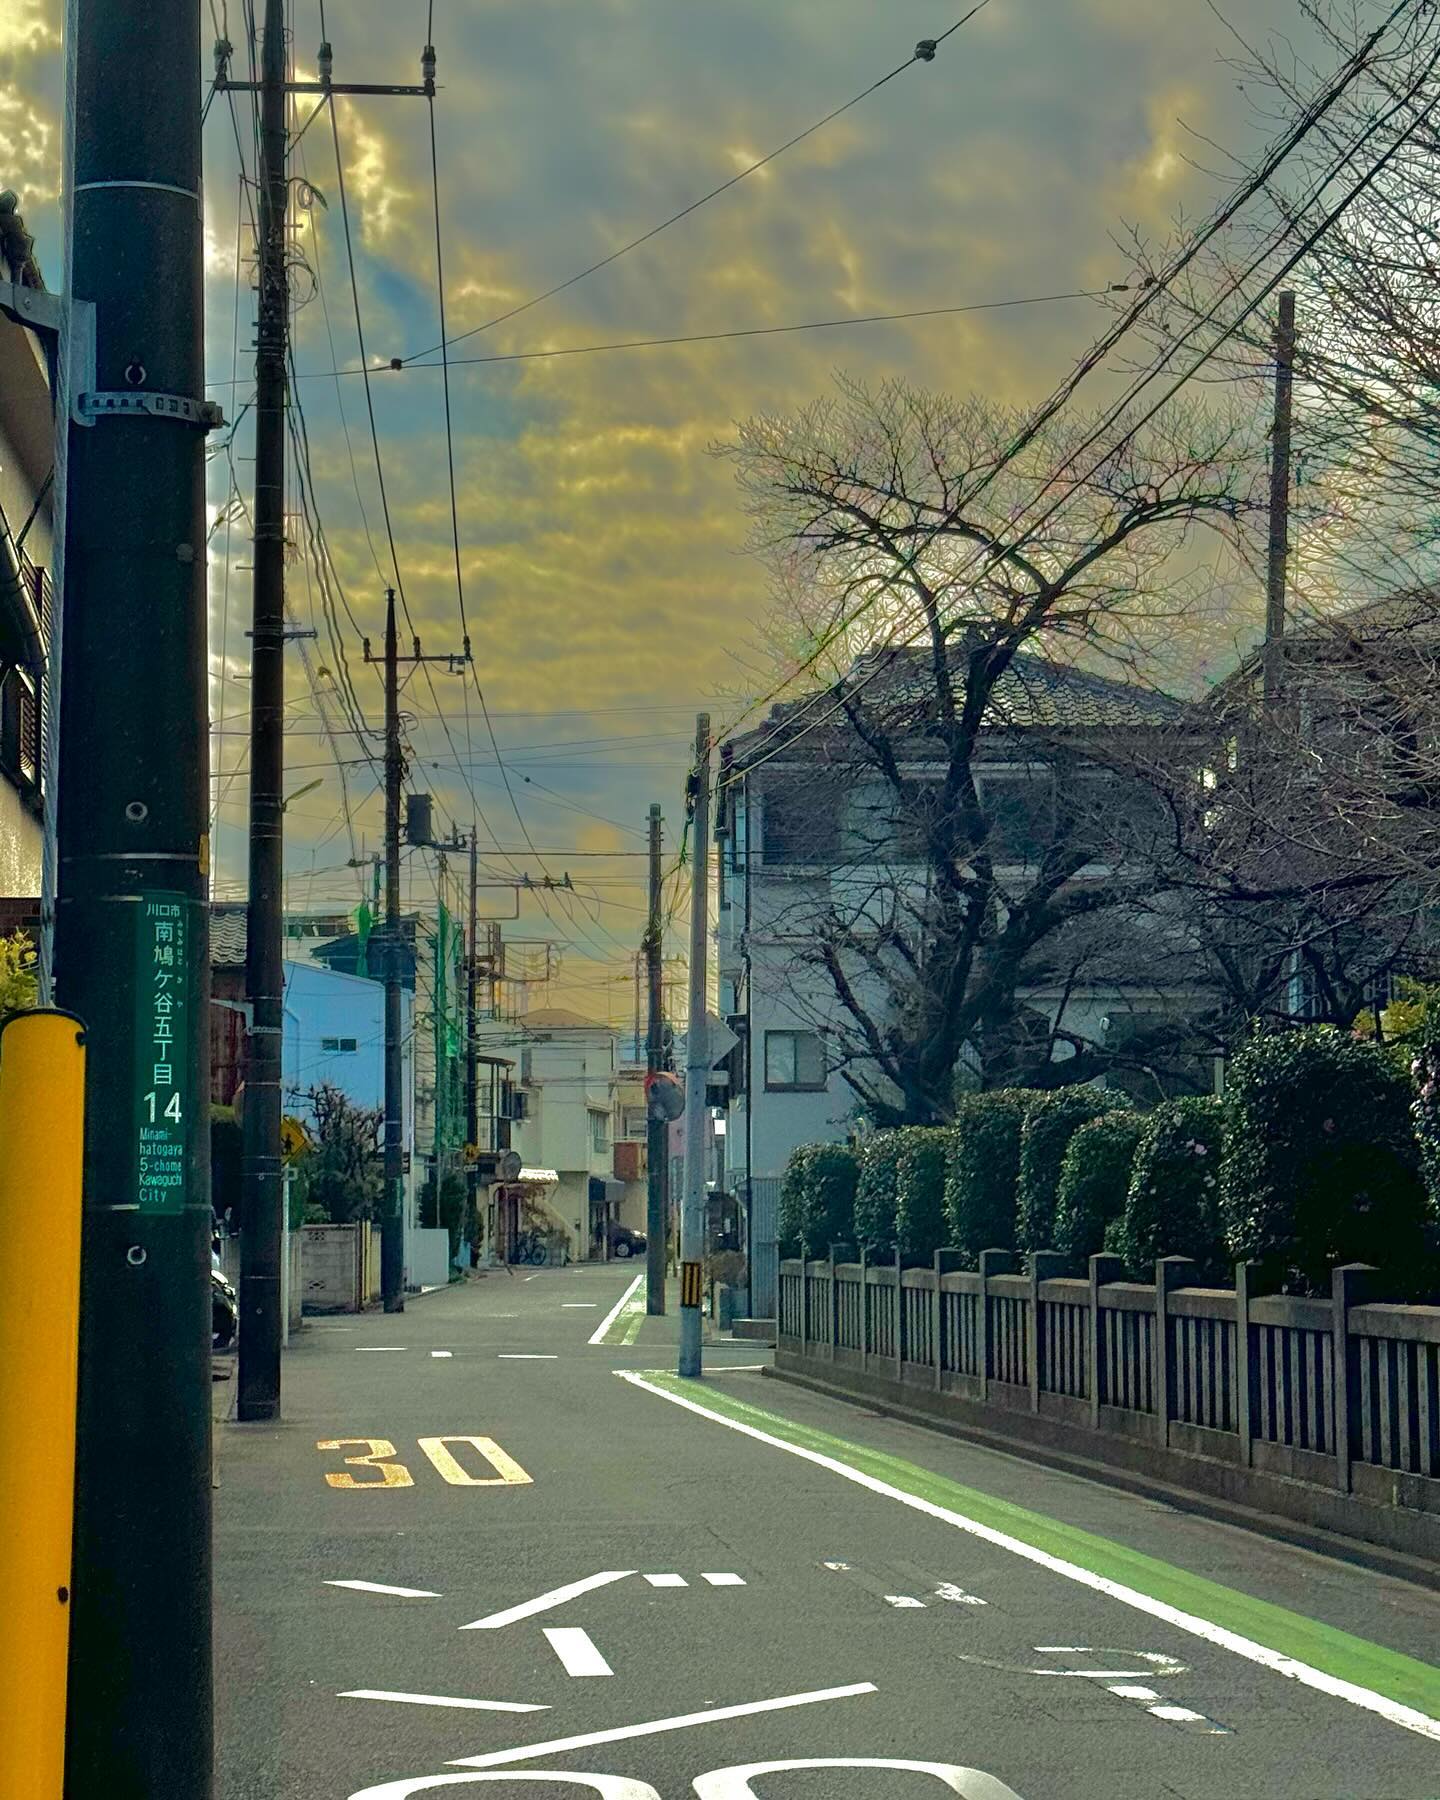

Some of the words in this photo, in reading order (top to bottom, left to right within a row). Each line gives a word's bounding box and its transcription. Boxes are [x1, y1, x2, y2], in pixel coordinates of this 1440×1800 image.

[146, 903, 181, 918] 川口市
[143, 1091, 182, 1124] 14
[139, 1127, 173, 1141] Minami-
[139, 1142, 183, 1157] hatogaya
[139, 1157, 182, 1172] 5-chome
[138, 1173, 182, 1188] Kawaguchi
[138, 1188, 167, 1203] City
[316, 1435, 534, 1489] 30
